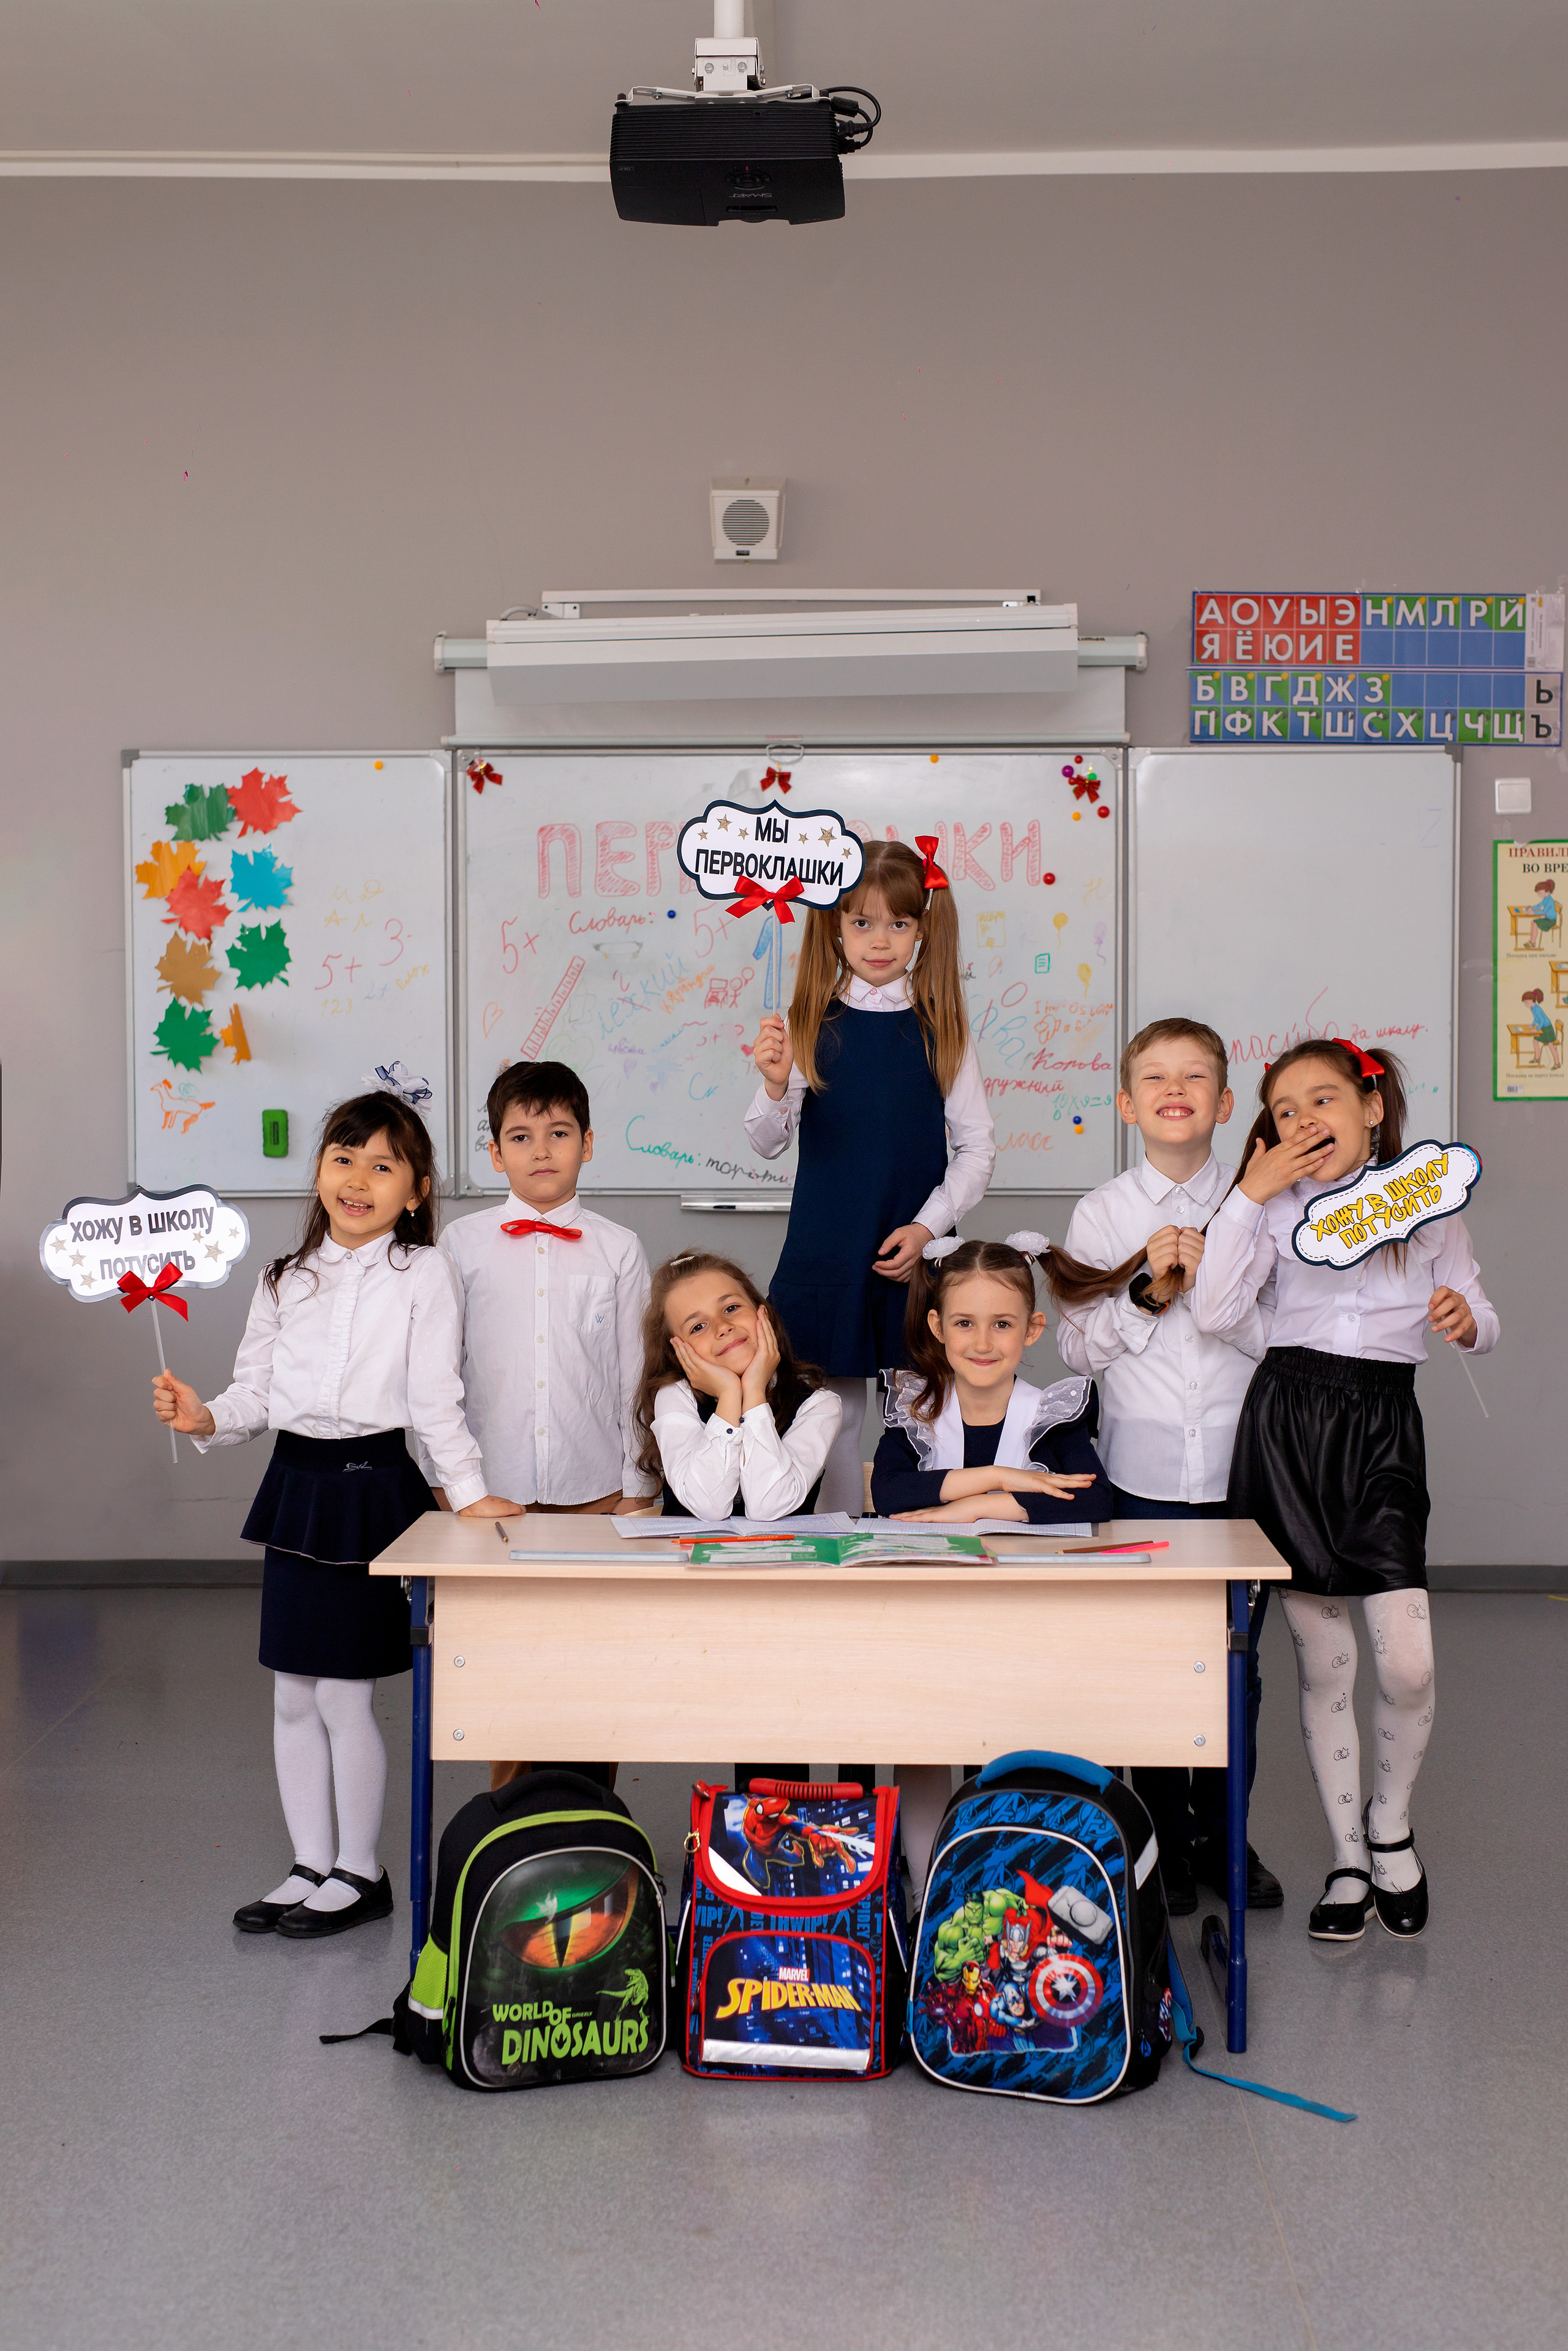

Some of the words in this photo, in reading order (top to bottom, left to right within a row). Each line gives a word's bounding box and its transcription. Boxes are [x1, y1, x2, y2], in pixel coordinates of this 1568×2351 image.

[755, 817, 789, 843] МЫ
[1509, 848, 1568, 857] ПРАВИЛ
[695, 848, 844, 886] ПЕРВОКЛАШКИ
[1523, 863, 1540, 873] ВО
[1031, 1047, 1112, 1072] Корова
[1310, 1198, 1363, 1242] ХОЖУ
[1365, 1194, 1388, 1212] В
[1383, 1153, 1449, 1202] ШКОЛУ
[1338, 1185, 1442, 1249] ПОТУСИТЬ
[778, 1967, 810, 1981] MARVEL
[492, 2001, 554, 2022] WORLD
[551, 2007, 571, 2026] OF
[502, 2019, 649, 2066] DINOSAURS
